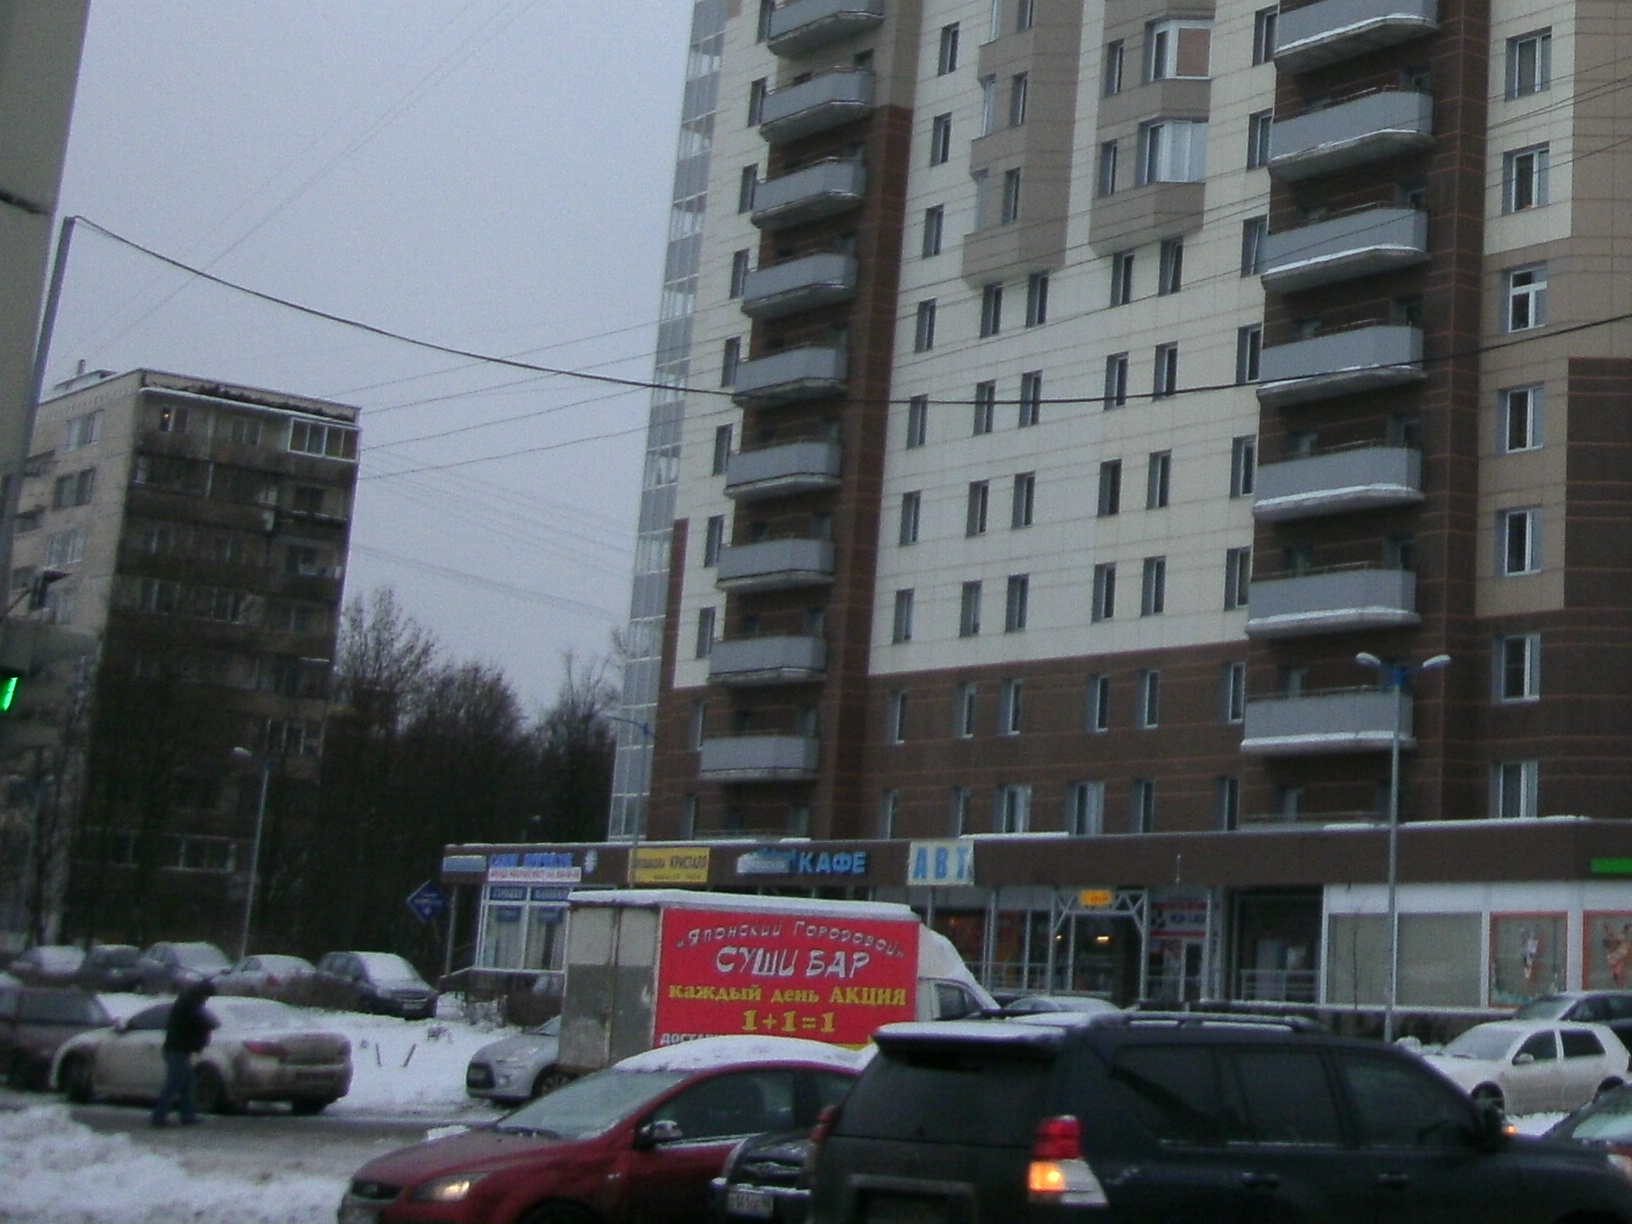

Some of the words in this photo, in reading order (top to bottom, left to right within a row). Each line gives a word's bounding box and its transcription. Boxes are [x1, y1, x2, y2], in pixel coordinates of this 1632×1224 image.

[799, 850, 867, 874] КАФЕ
[715, 945, 800, 977] СУШИ
[805, 949, 871, 979] БАР
[770, 987, 820, 1003] день
[829, 986, 906, 1006] АКЦИЯ
